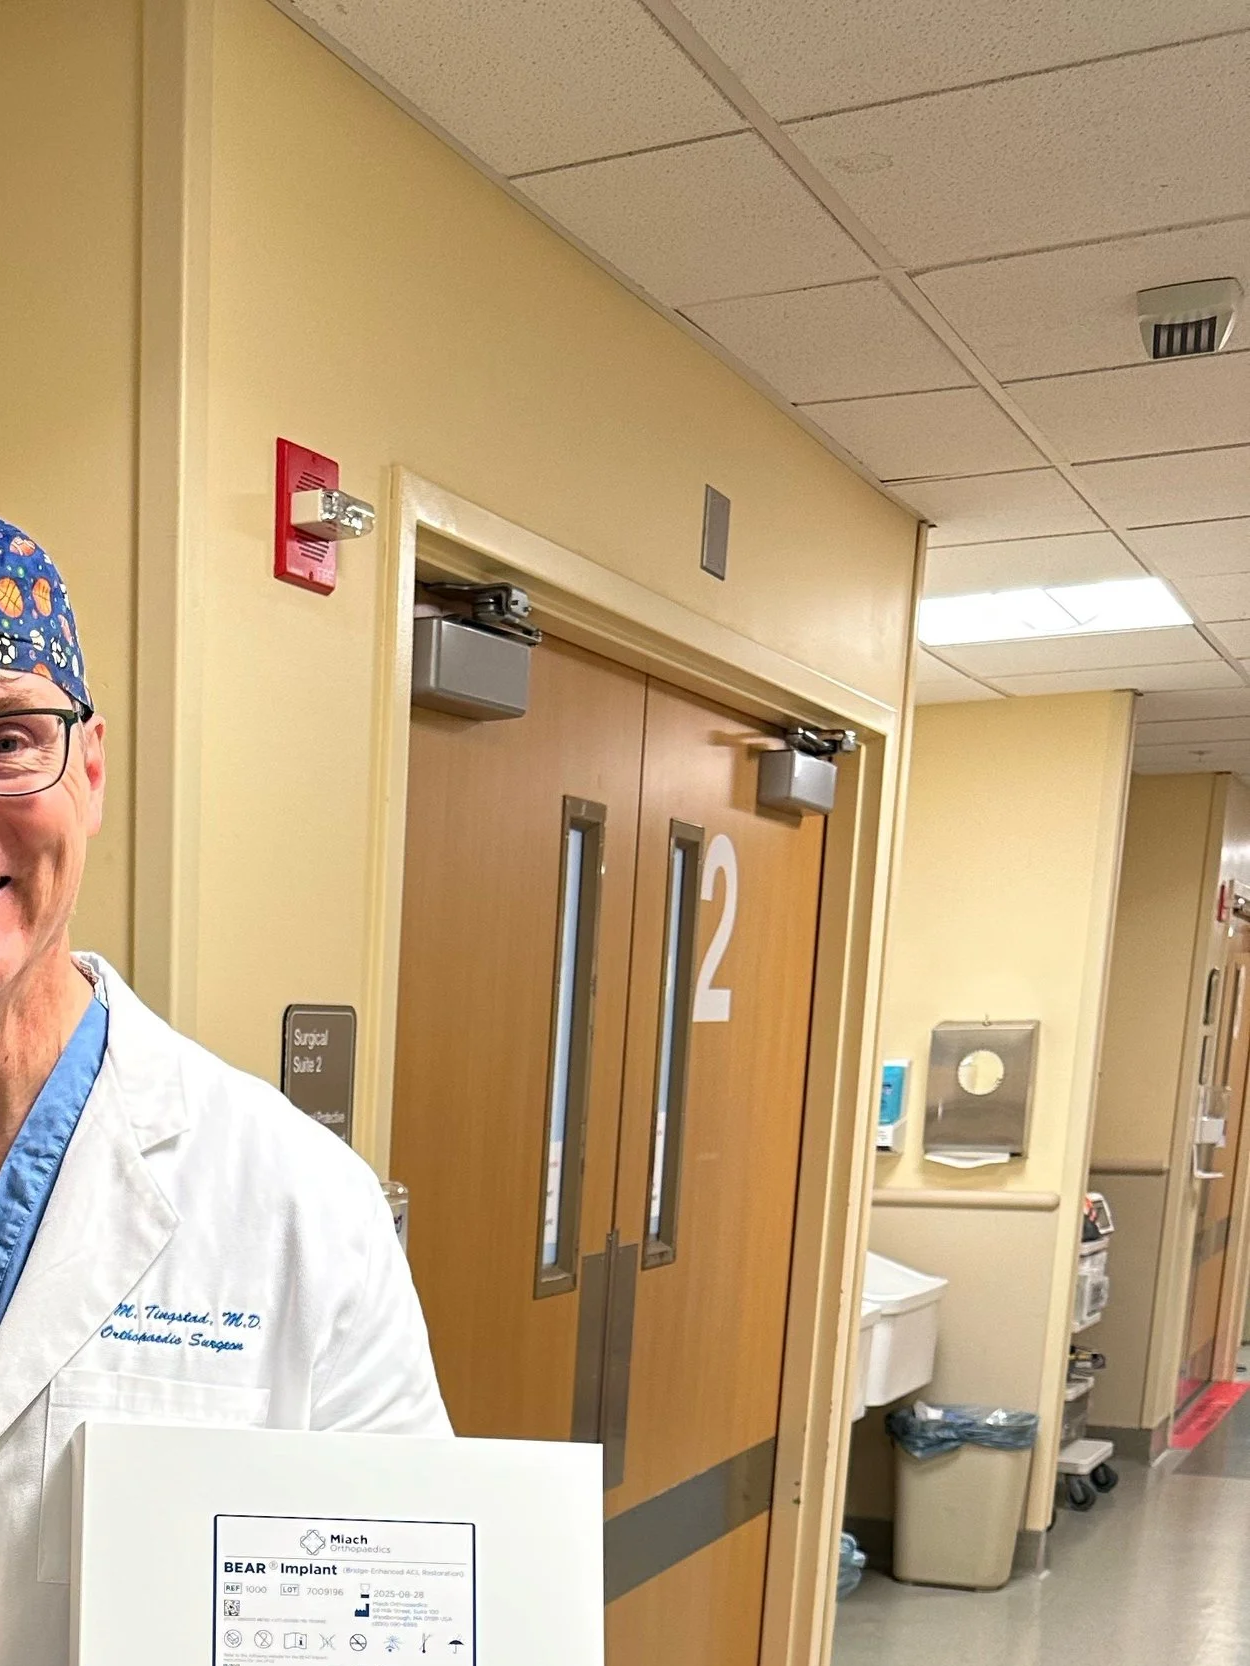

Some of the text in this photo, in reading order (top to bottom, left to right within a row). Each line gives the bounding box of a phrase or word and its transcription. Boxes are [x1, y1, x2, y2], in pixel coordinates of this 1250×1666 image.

[692, 833, 738, 1023] 2
[293, 1029, 328, 1050] Surgical
[293, 1056, 322, 1074] Suite 2
[112, 1302, 262, 1330] M. Tingstad, M.D.
[100, 1324, 244, 1353] Orthopaedic Surgeon
[330, 1534, 368, 1545] Miach
[330, 1544, 391, 1554] Orthopaedics
[223, 1561, 267, 1574] BEAR
[280, 1562, 338, 1577] Implant
[225, 1584, 241, 1592] REF
[245, 1585, 268, 1594] 1000
[281, 1586, 298, 1594] LOT
[306, 1587, 345, 1596] 7009196
[373, 1590, 425, 1599] 2025-08-28
